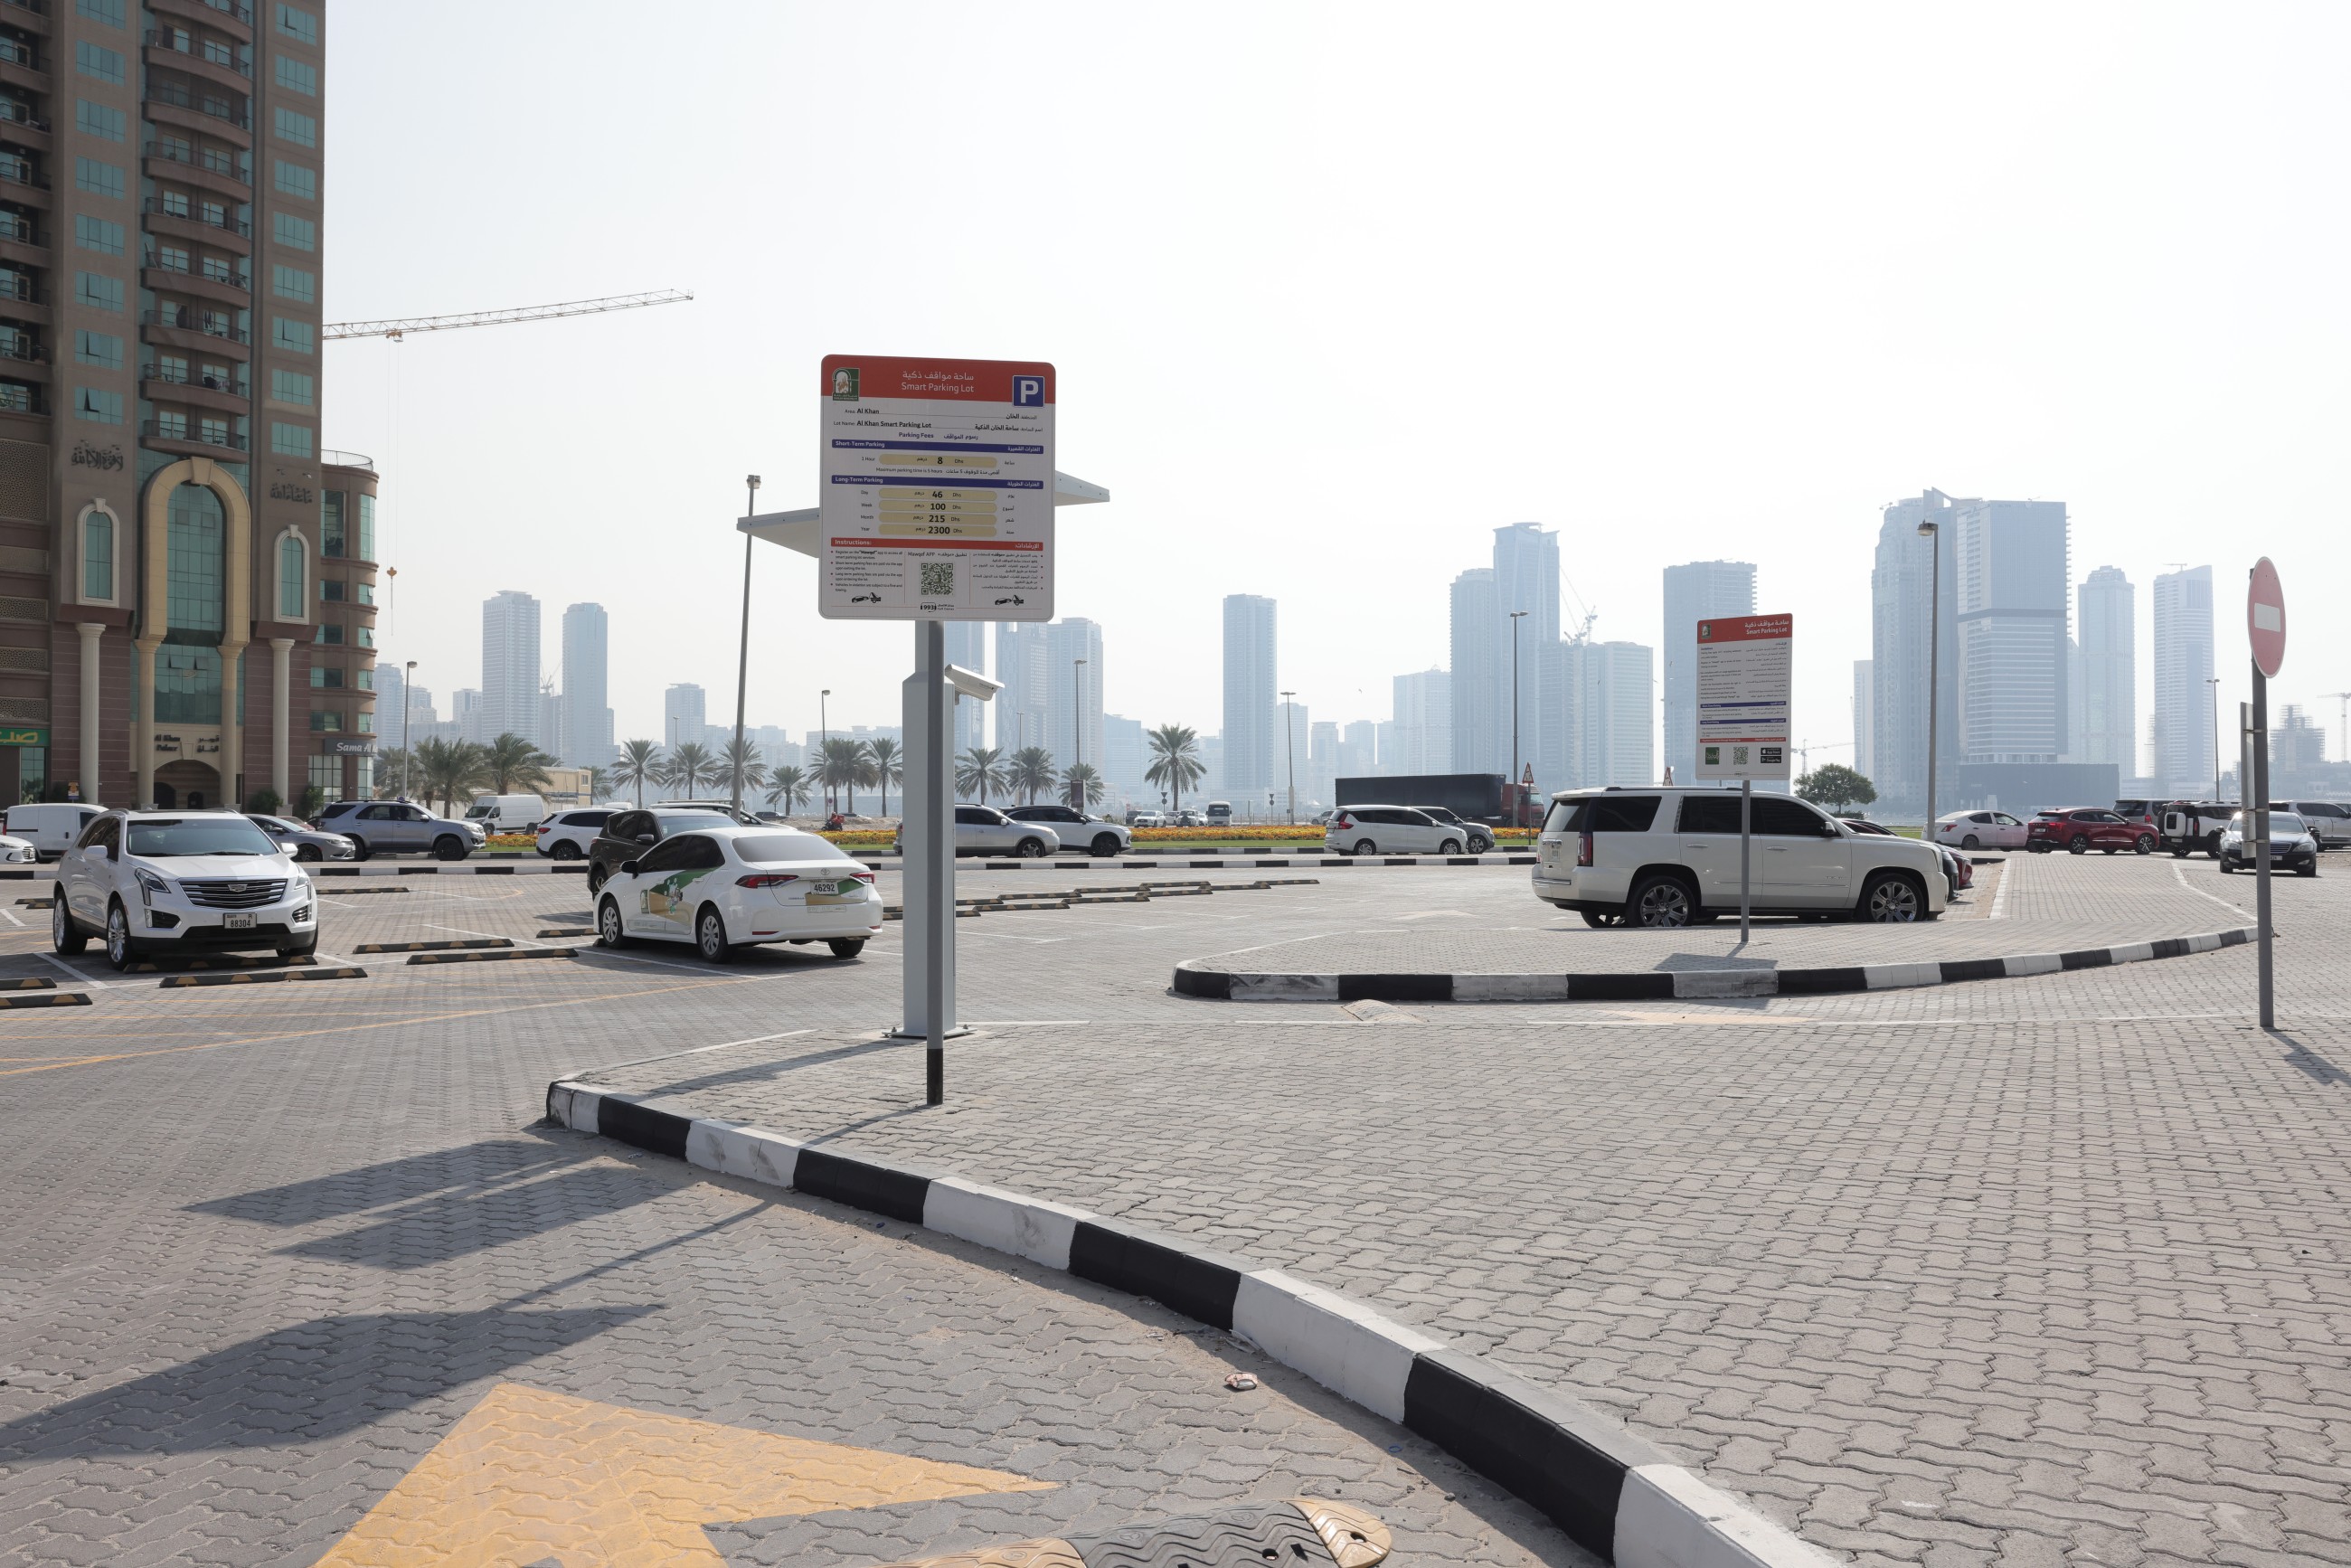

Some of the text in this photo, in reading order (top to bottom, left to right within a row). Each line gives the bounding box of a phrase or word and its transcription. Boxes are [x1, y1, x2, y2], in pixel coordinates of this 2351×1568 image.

[902, 370, 974, 382] ساحة مواقف ذكية
[902, 382, 974, 394] Smart Parking Lot
[1020, 380, 1039, 403] P
[937, 456, 943, 465] 8
[929, 515, 945, 523] 215
[928, 526, 950, 534] 2300
[336, 742, 363, 752] Sama
[814, 883, 836, 892] 46292
[230, 920, 251, 928] 88304
